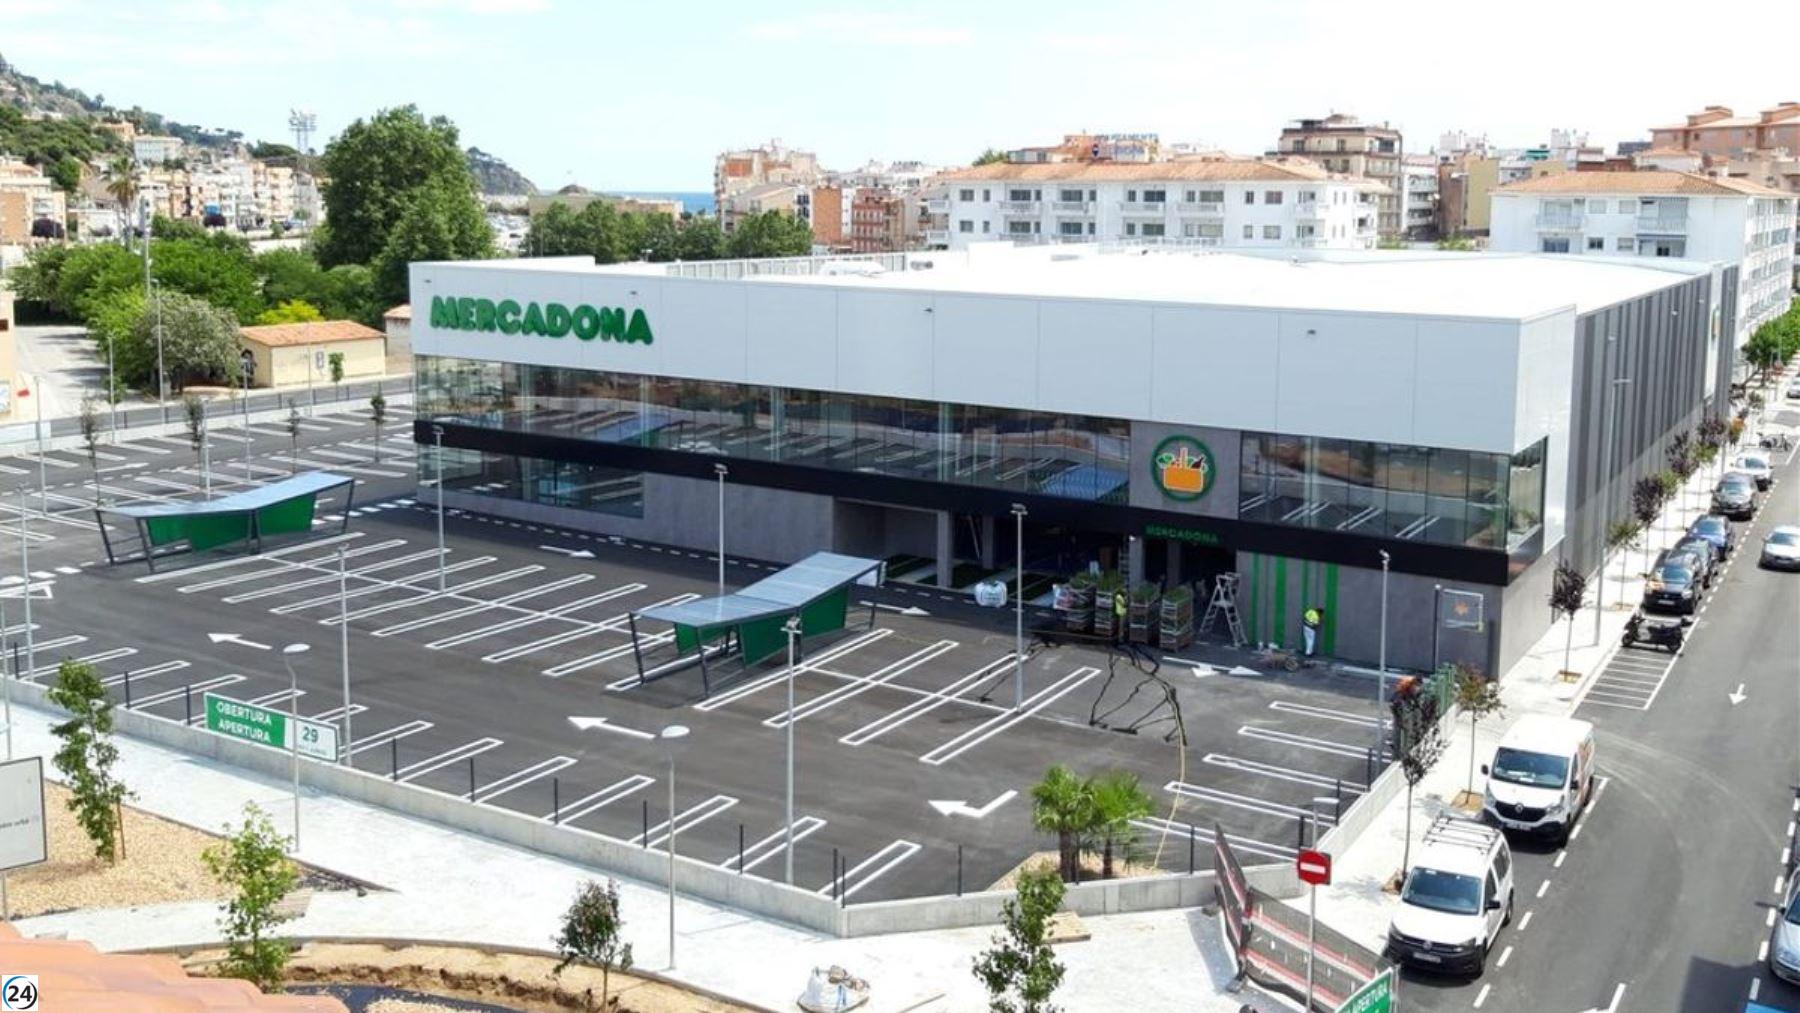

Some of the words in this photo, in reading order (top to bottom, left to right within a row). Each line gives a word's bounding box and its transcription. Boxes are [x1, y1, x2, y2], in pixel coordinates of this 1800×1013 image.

[430, 295, 654, 345] MERCADONA
[1145, 523, 1219, 544] MERCADONA
[216, 702, 272, 726] OBERTURA
[218, 719, 272, 743] APERTURA
[302, 726, 319, 743] 29
